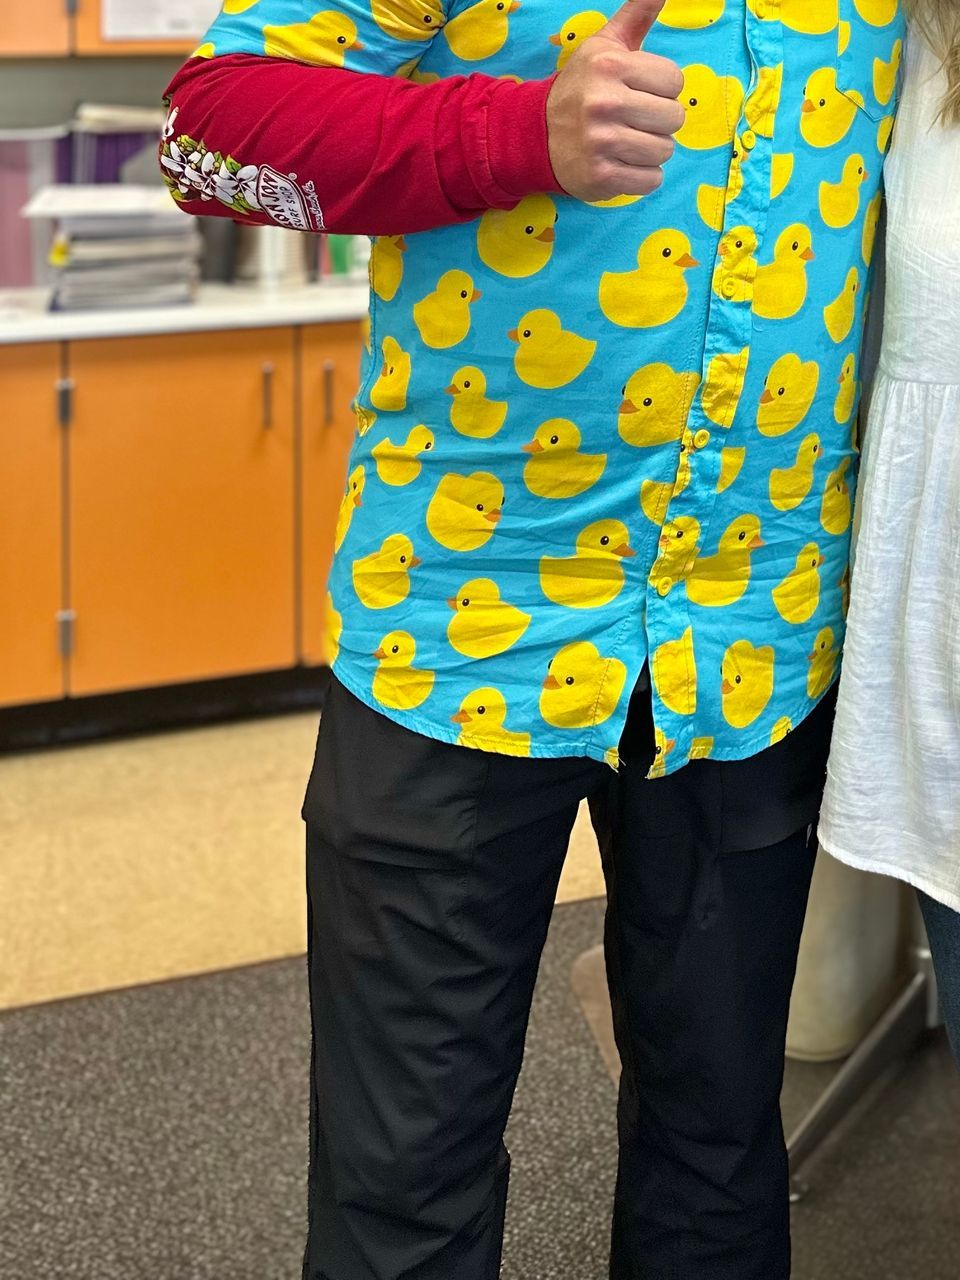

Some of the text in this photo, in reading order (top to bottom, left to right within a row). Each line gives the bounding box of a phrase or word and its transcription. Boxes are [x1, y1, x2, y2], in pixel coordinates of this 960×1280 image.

[261, 172, 280, 202] JON
[279, 186, 305, 228] SURF SHOP
